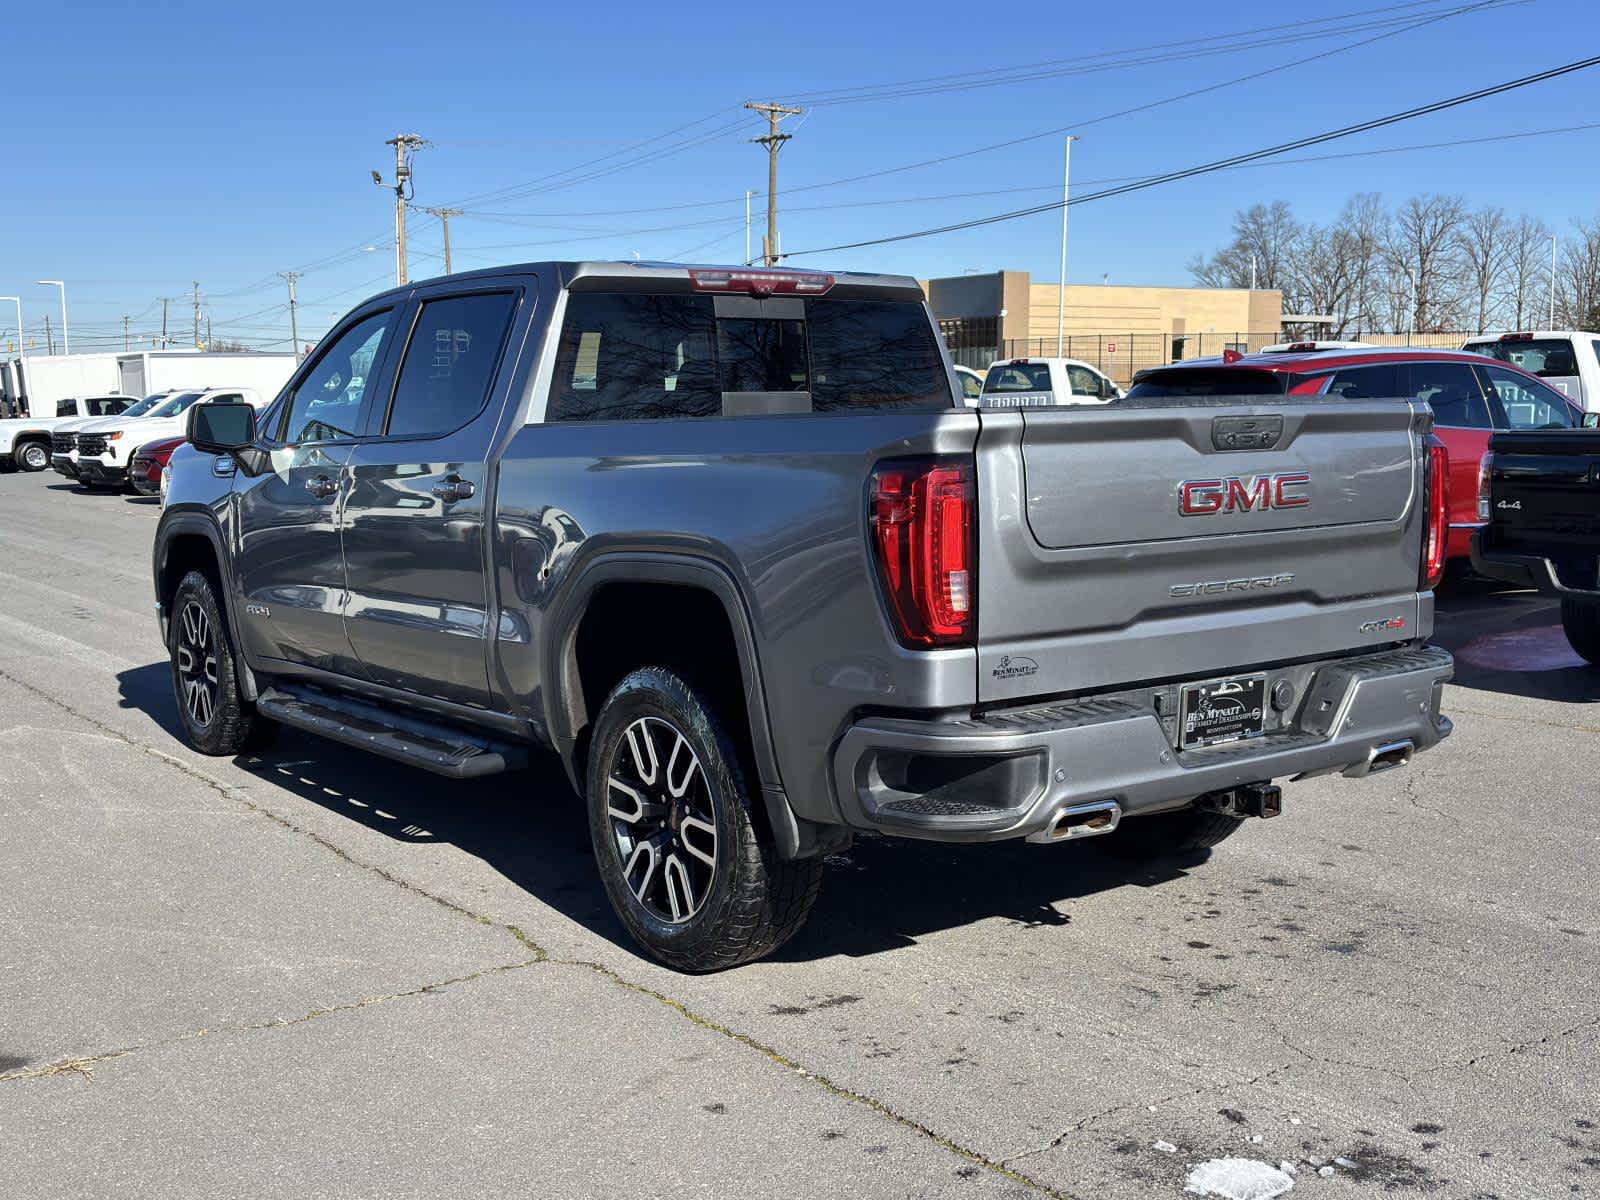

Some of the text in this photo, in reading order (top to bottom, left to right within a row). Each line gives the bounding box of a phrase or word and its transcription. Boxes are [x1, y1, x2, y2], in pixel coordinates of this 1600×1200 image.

[1177, 471, 1310, 517] GMC
[1168, 572, 1295, 598] SIERRA
[1206, 706, 1242, 720] MYNATT
